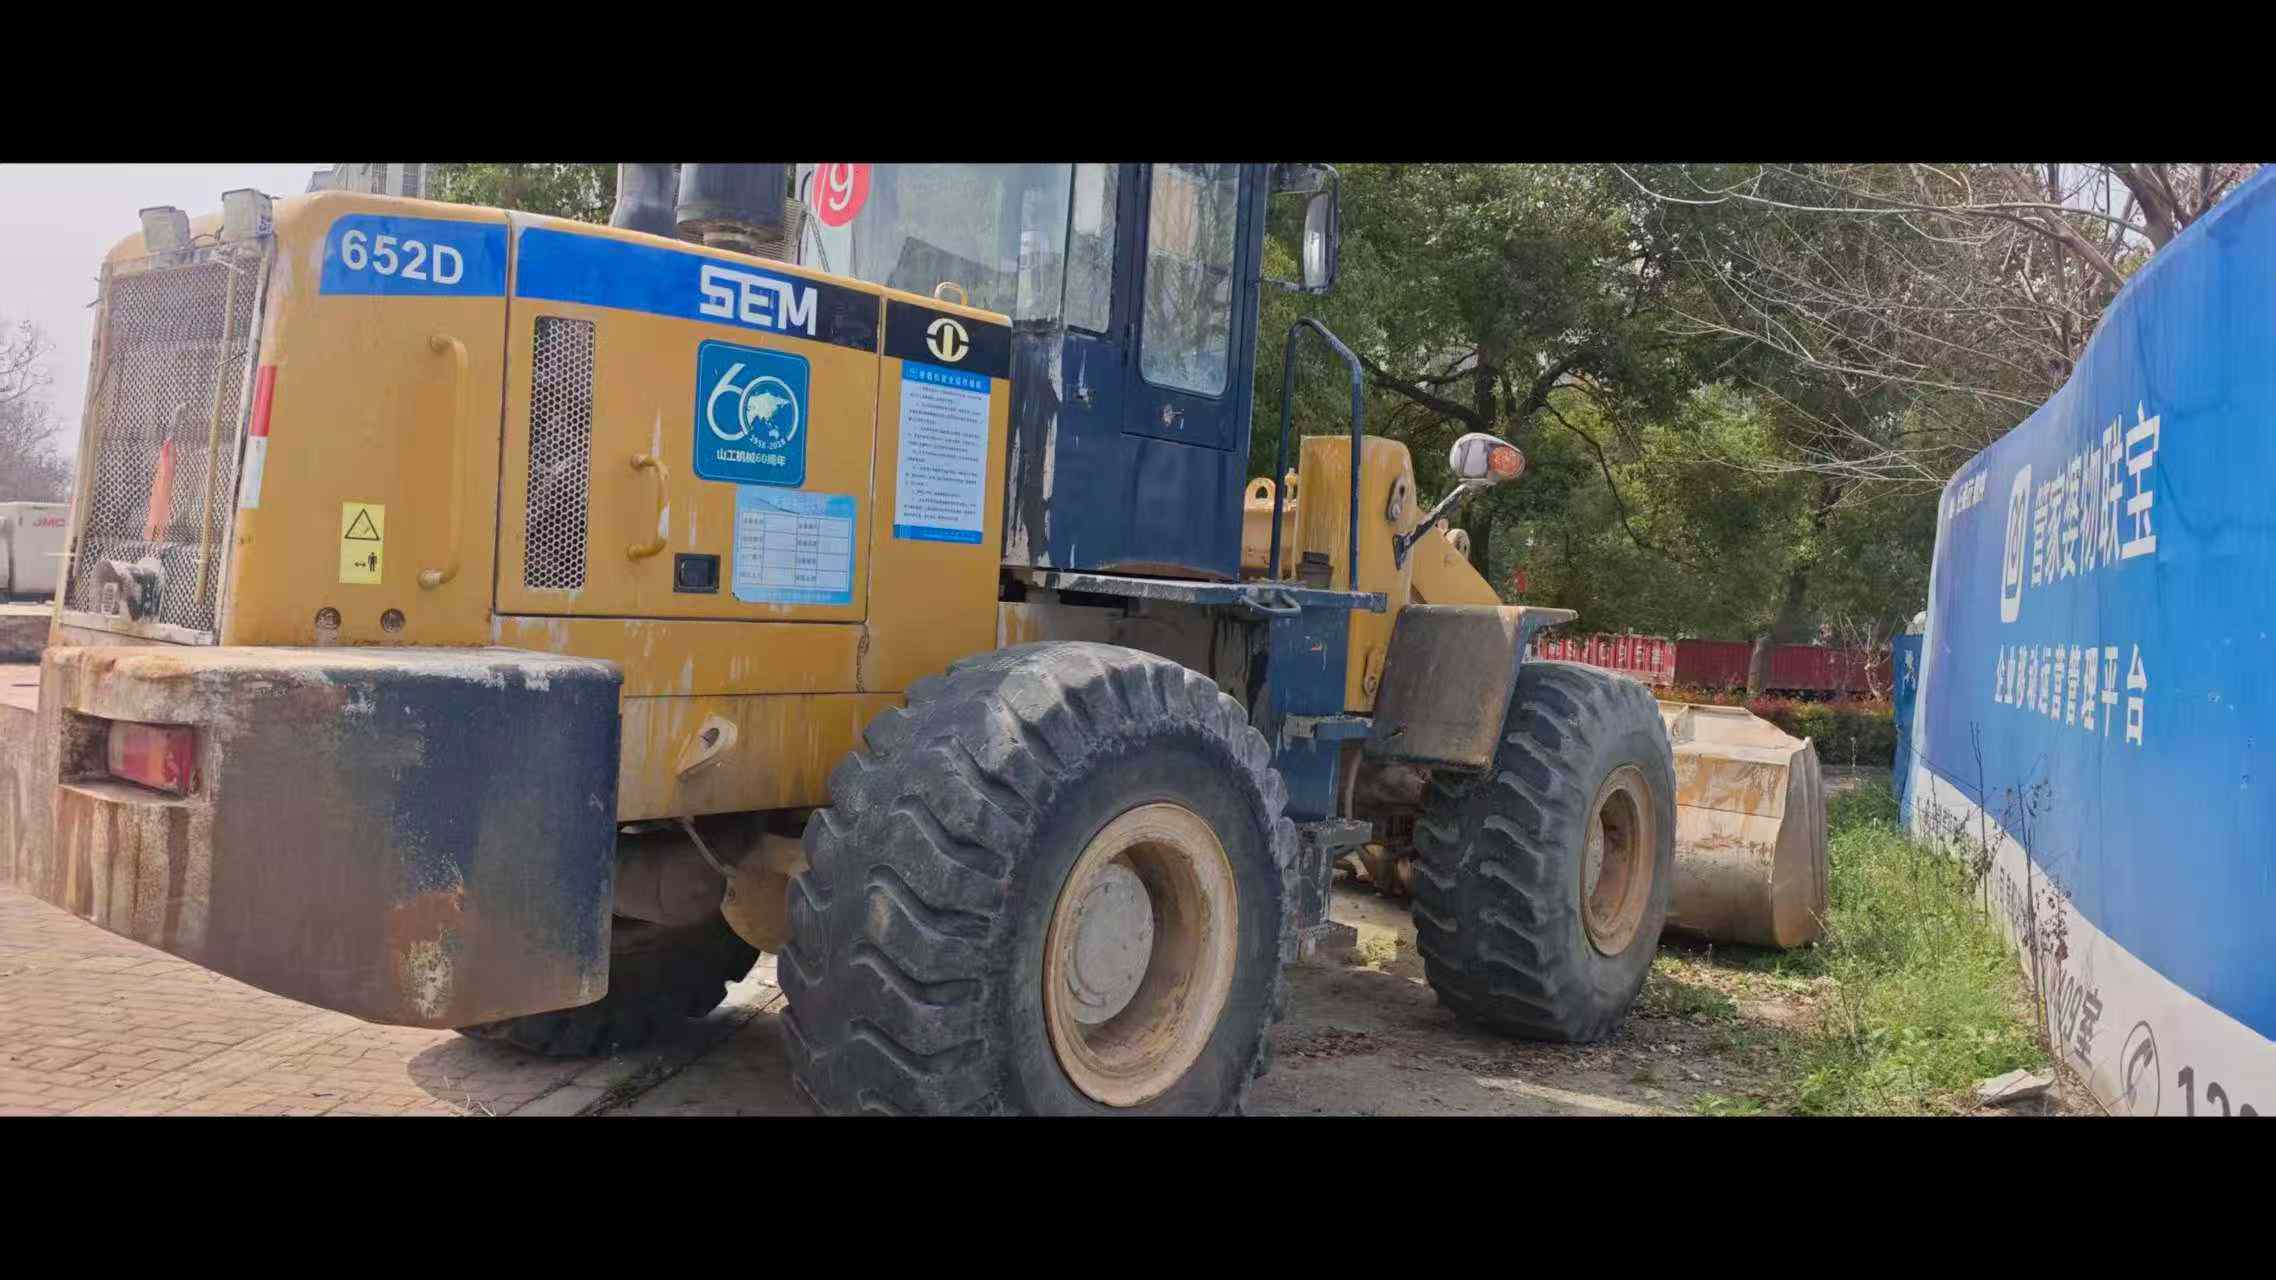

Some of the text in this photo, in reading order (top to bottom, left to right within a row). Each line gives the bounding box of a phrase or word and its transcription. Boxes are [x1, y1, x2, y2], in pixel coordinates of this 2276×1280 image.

[339, 228, 464, 285] 652D
[699, 264, 818, 336] SEM
[707, 362, 799, 442] 60
[2030, 400, 2161, 586] 管家婆物联宝
[1994, 643, 2148, 747] 企业移动运营管理平台
